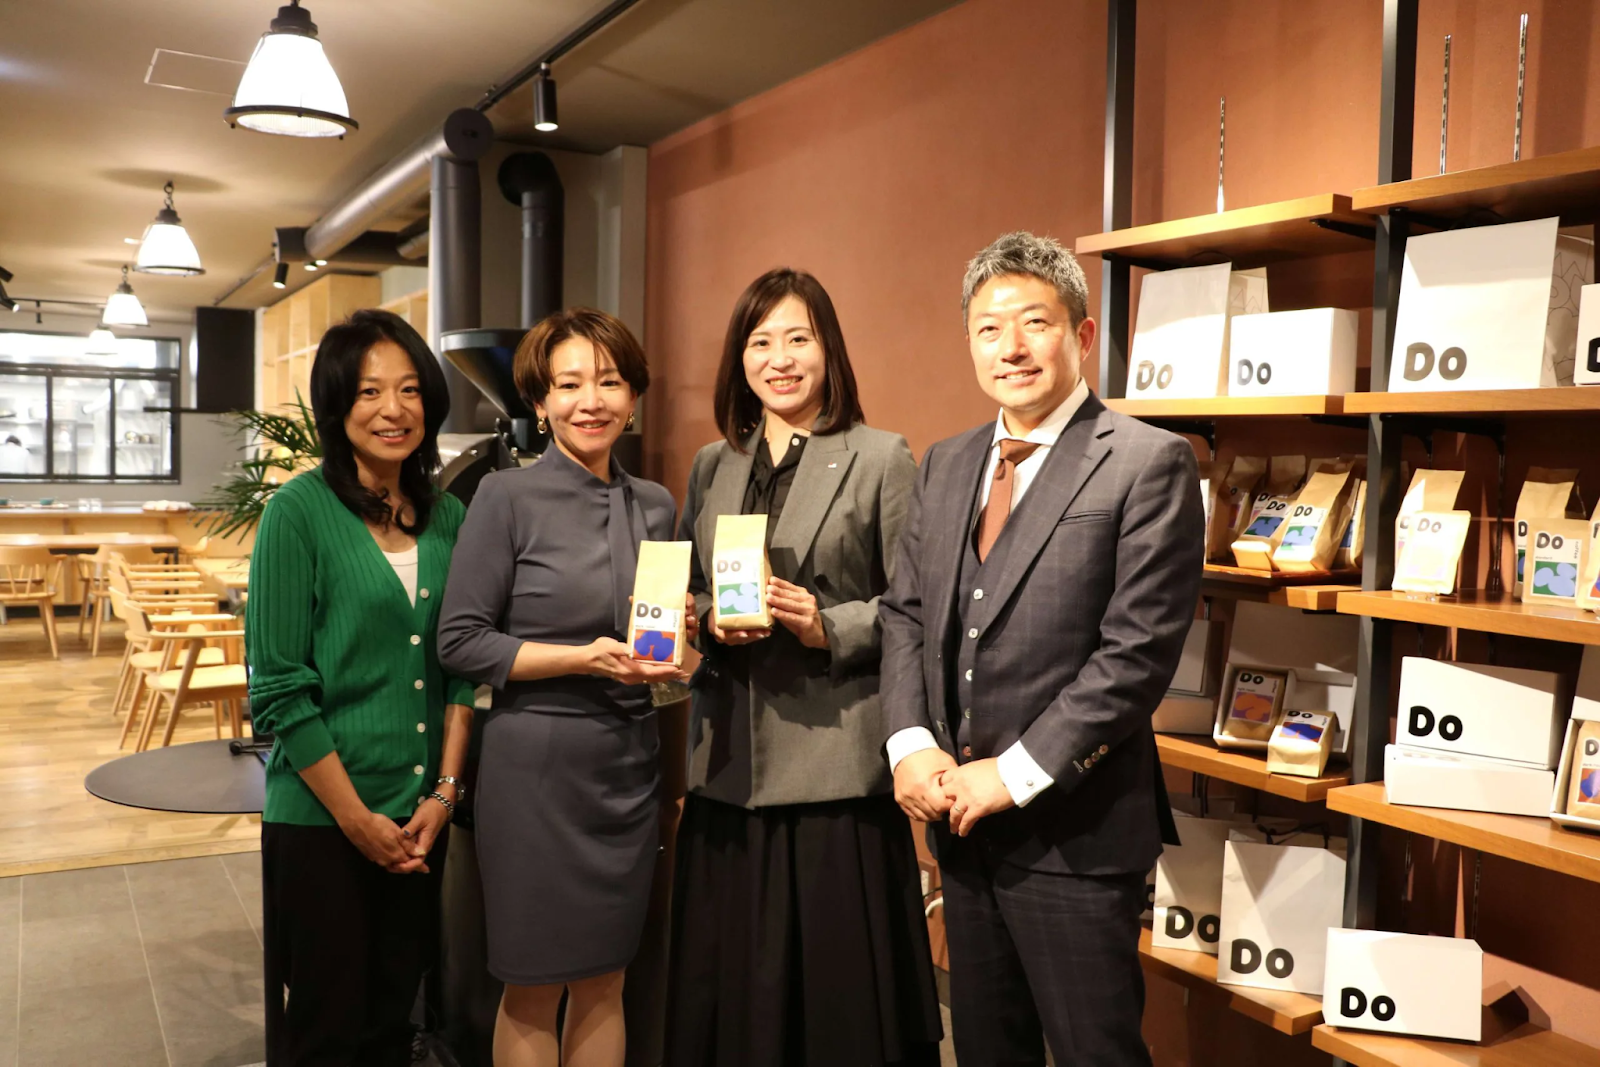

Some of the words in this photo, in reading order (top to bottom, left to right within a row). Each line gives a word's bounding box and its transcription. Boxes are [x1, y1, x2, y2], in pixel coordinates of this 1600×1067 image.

[1402, 342, 1467, 381] Do
[1135, 360, 1173, 391] Do
[1237, 359, 1272, 386] Do
[1266, 500, 1286, 511] Do
[1293, 505, 1313, 517] Do
[1417, 518, 1442, 533] Do
[1536, 532, 1563, 550] Do
[717, 559, 741, 573] Do
[636, 602, 662, 619] Do
[1239, 672, 1264, 685] Do
[1287, 710, 1313, 719] Do
[1408, 705, 1463, 741] Do
[1165, 905, 1220, 943] Do
[1230, 938, 1294, 979] Do
[1340, 986, 1396, 1021] Do
